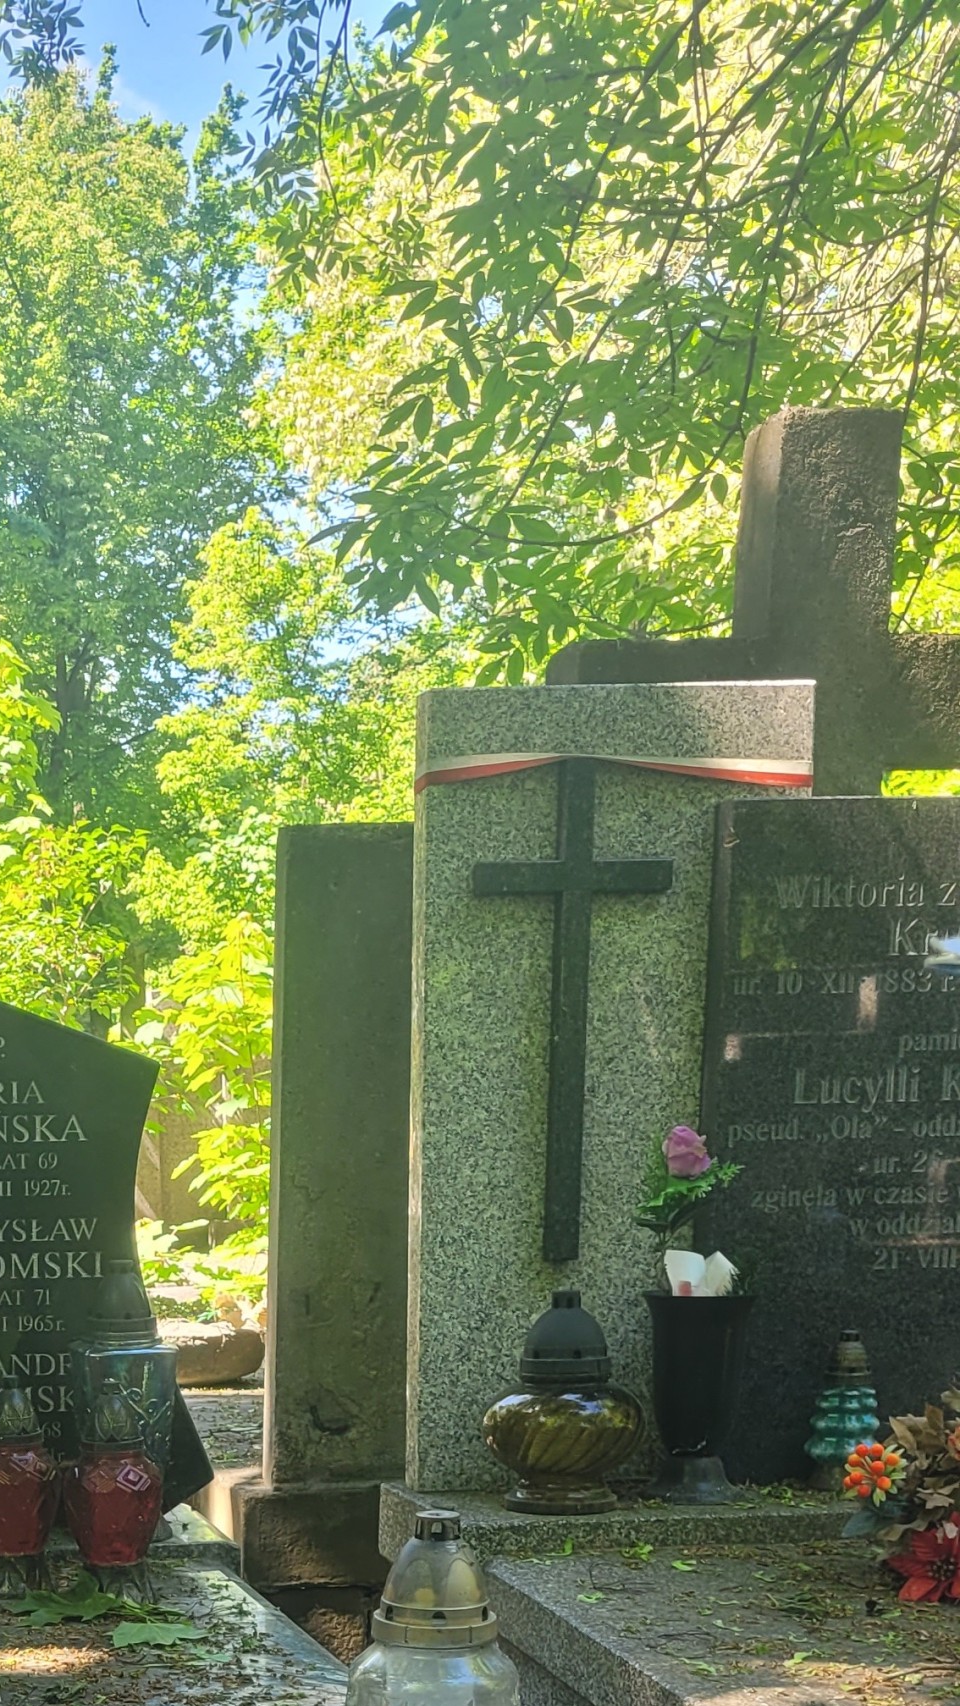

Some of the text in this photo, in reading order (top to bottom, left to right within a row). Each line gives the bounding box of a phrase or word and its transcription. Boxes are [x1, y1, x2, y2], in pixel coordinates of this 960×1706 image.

[774, 874, 925, 908] Wiktoria
[898, 1028, 960, 1057] pami
[793, 1064, 920, 1113] Lucylli
[38, 1152, 58, 1170] 69
[24, 1179, 72, 1197] 1927r.
[846, 1187, 867, 1206] w
[849, 1217, 869, 1236] w
[34, 1289, 51, 1305] 71
